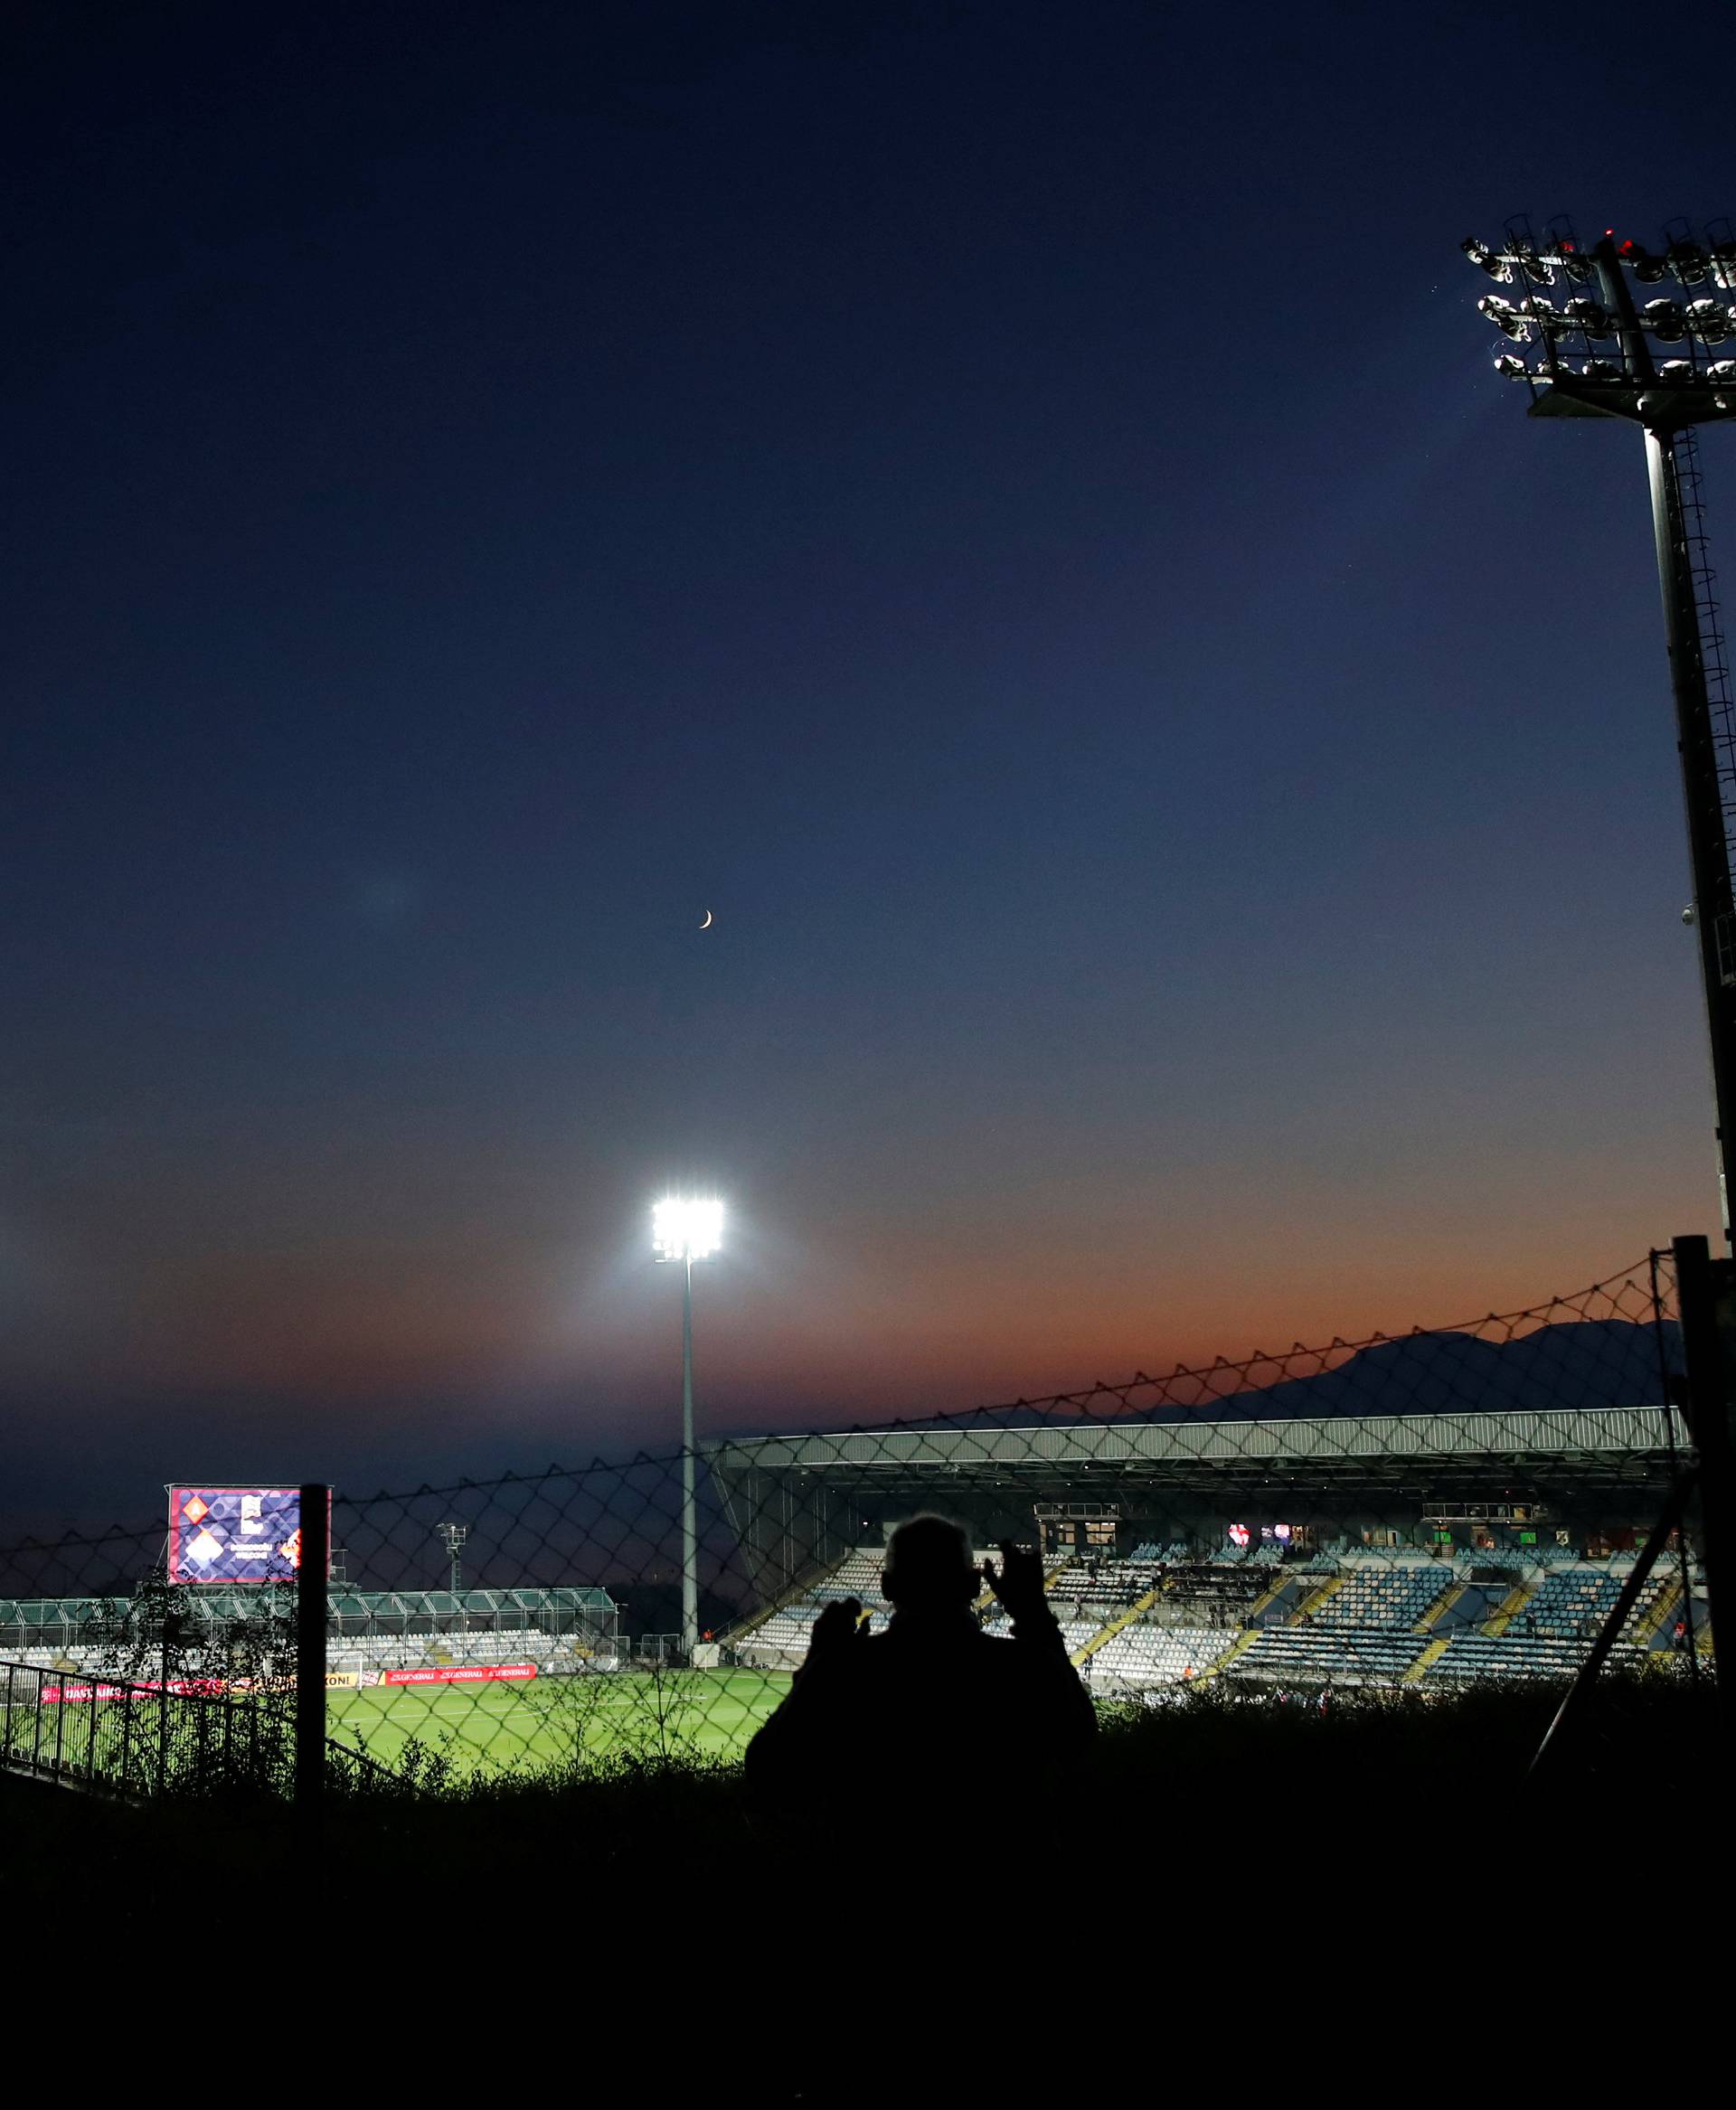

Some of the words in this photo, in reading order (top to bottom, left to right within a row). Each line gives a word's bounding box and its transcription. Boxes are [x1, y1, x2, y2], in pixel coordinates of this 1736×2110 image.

[191, 1502, 201, 1515] A
[401, 1672, 434, 1681] GENERALI
[450, 1671, 483, 1679] GENERALI
[498, 1668, 530, 1677] GENERALI
